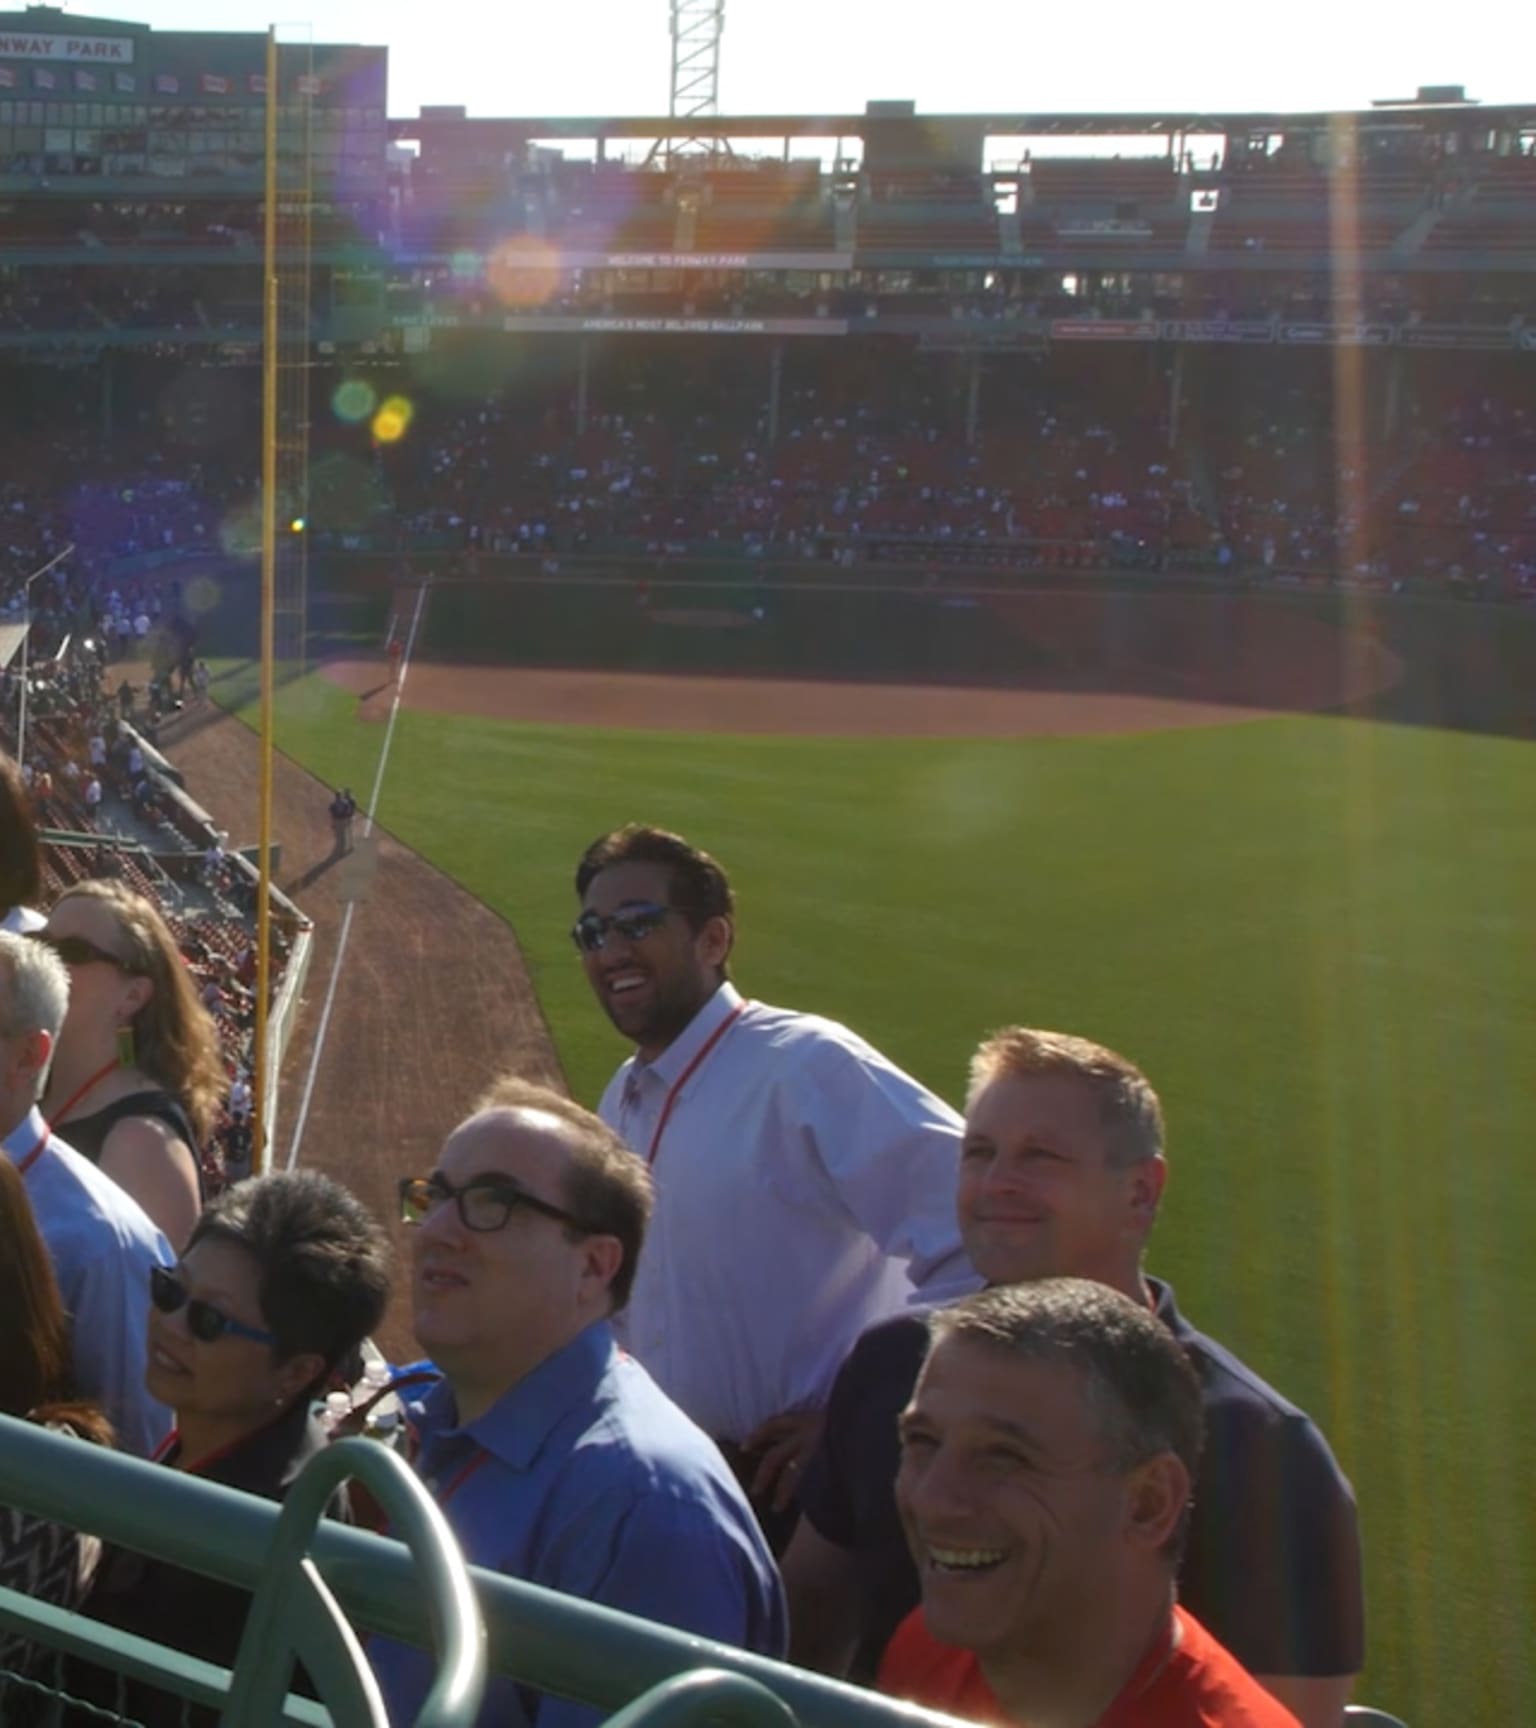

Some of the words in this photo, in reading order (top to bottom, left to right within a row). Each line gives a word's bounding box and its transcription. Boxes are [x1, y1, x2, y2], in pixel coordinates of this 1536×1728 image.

[66, 39, 122, 58] PARK
[672, 255, 717, 266] FENWAY
[718, 255, 748, 266] PARK
[635, 319, 663, 331] MOST
[665, 319, 710, 331] BELOVED
[712, 319, 765, 331] BALLPARK
